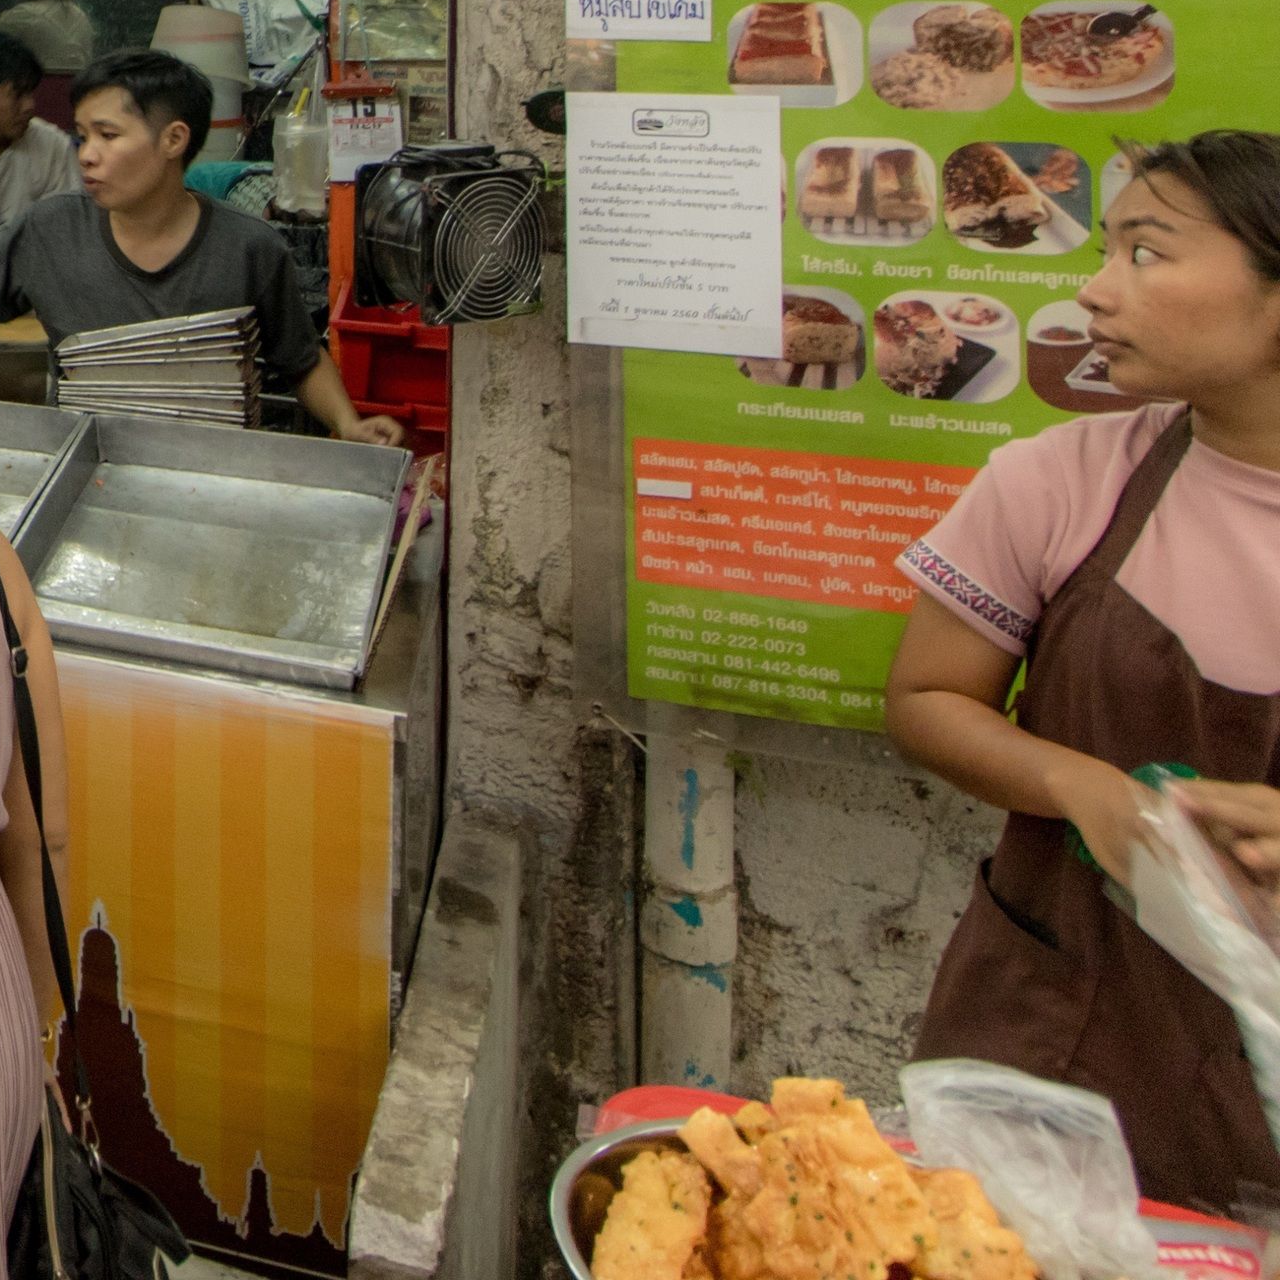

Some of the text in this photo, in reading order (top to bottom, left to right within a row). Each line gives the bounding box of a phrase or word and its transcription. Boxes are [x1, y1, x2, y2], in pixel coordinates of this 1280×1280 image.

[872, 260, 933, 279] สังขยา
[701, 630, 807, 657] 02-222-0073
